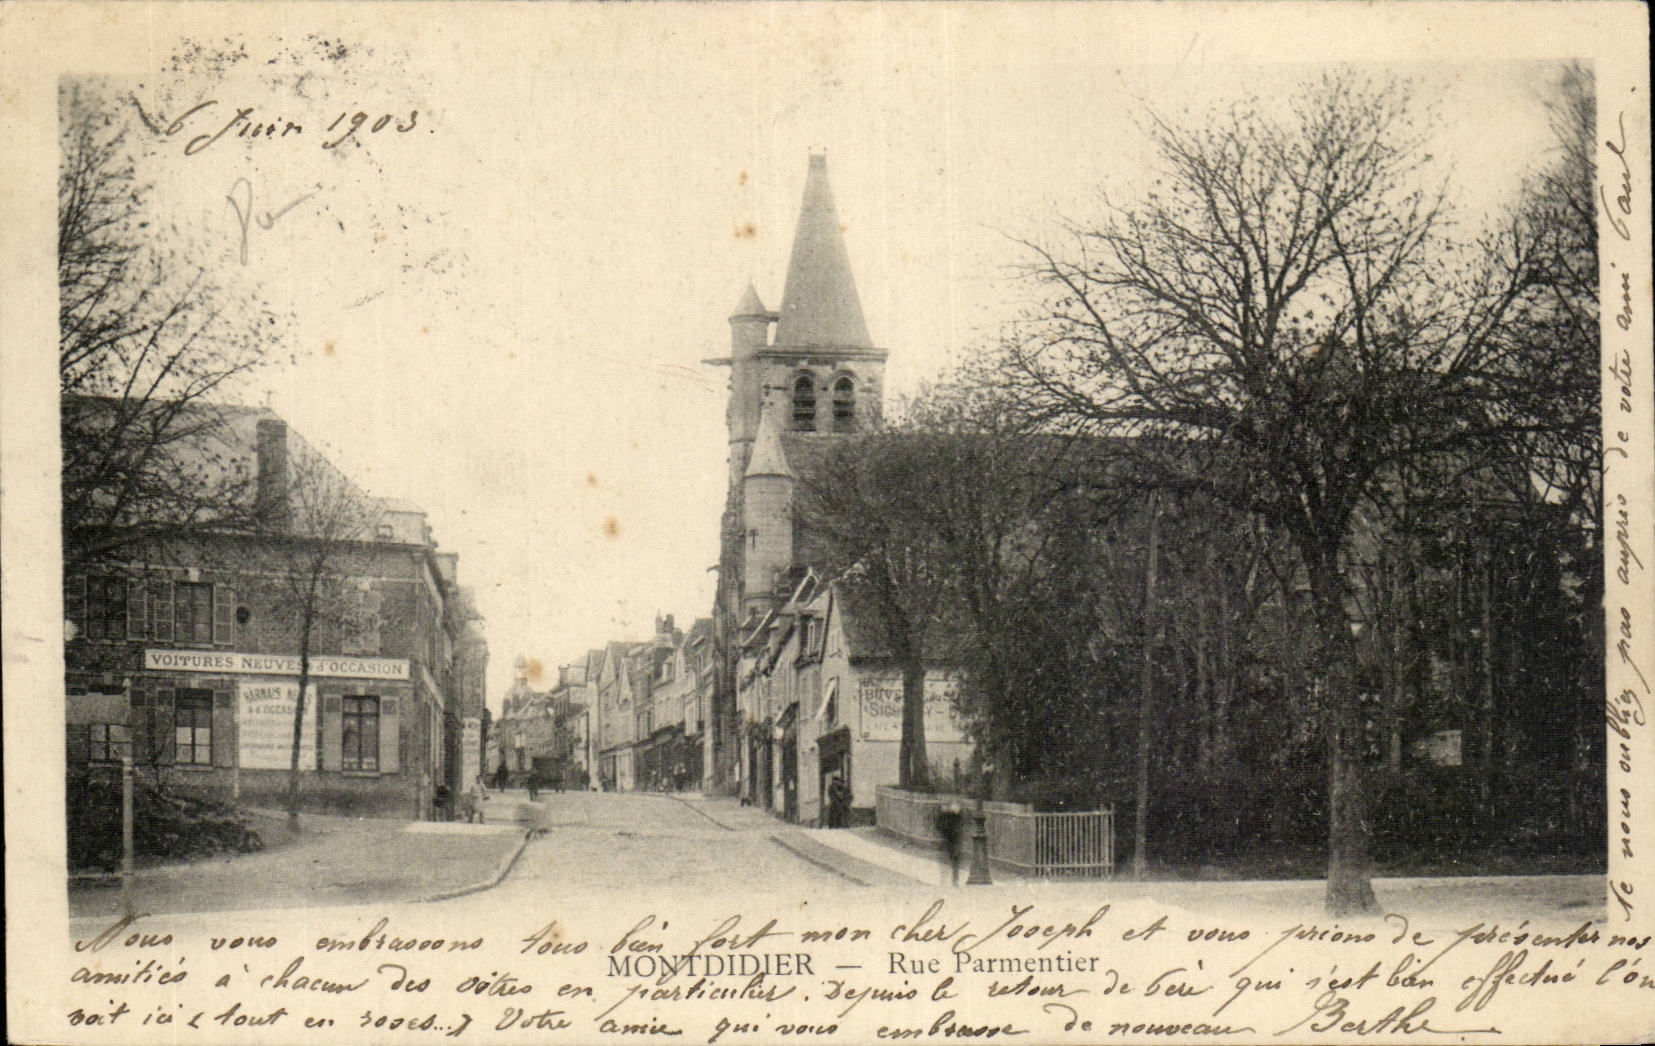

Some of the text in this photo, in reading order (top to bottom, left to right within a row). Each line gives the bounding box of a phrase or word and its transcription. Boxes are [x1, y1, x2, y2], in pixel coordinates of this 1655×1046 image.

[1610, 261, 1633, 330] ami
[1608, 348, 1633, 412] votre
[1603, 430, 1628, 473] de
[151, 654, 234, 668] VOITURES
[317, 661, 403, 675] d'OCCASION
[1615, 606, 1651, 693] pas
[1605, 688, 1646, 773] oubliez
[1619, 786, 1634, 858] nous
[75, 913, 173, 953] Nous
[211, 935, 278, 950] vous
[315, 917, 483, 952] embrassons
[520, 920, 588, 955] tous
[610, 914, 669, 954] bien
[656, 914, 794, 986] fort
[801, 928, 870, 942] mon
[890, 899, 970, 943] cher
[952, 904, 1111, 955] Joseph
[1122, 915, 1168, 942] et
[1187, 927, 1249, 943] vous
[1230, 923, 1376, 977] prions
[1384, 913, 1434, 945] de
[1608, 934, 1652, 950] nos
[71, 956, 188, 985] amitiés
[215, 963, 249, 988] à
[260, 955, 370, 993] chacun
[377, 963, 432, 993] des
[558, 982, 593, 997] en
[988, 975, 1091, 998] retour
[1103, 969, 1131, 996] de
[1213, 968, 1294, 1016] qui
[1386, 953, 1434, 989] bien
[68, 1000, 130, 1027] voit
[143, 1003, 183, 1025] ici
[304, 1013, 335, 1028] en
[496, 1006, 572, 1032] Votre
[600, 1015, 683, 1036] amie
[707, 1013, 771, 1044] qui
[776, 1023, 837, 1036] vous
[1043, 1003, 1093, 1033] de
[1108, 1020, 1257, 1036] nouveau
